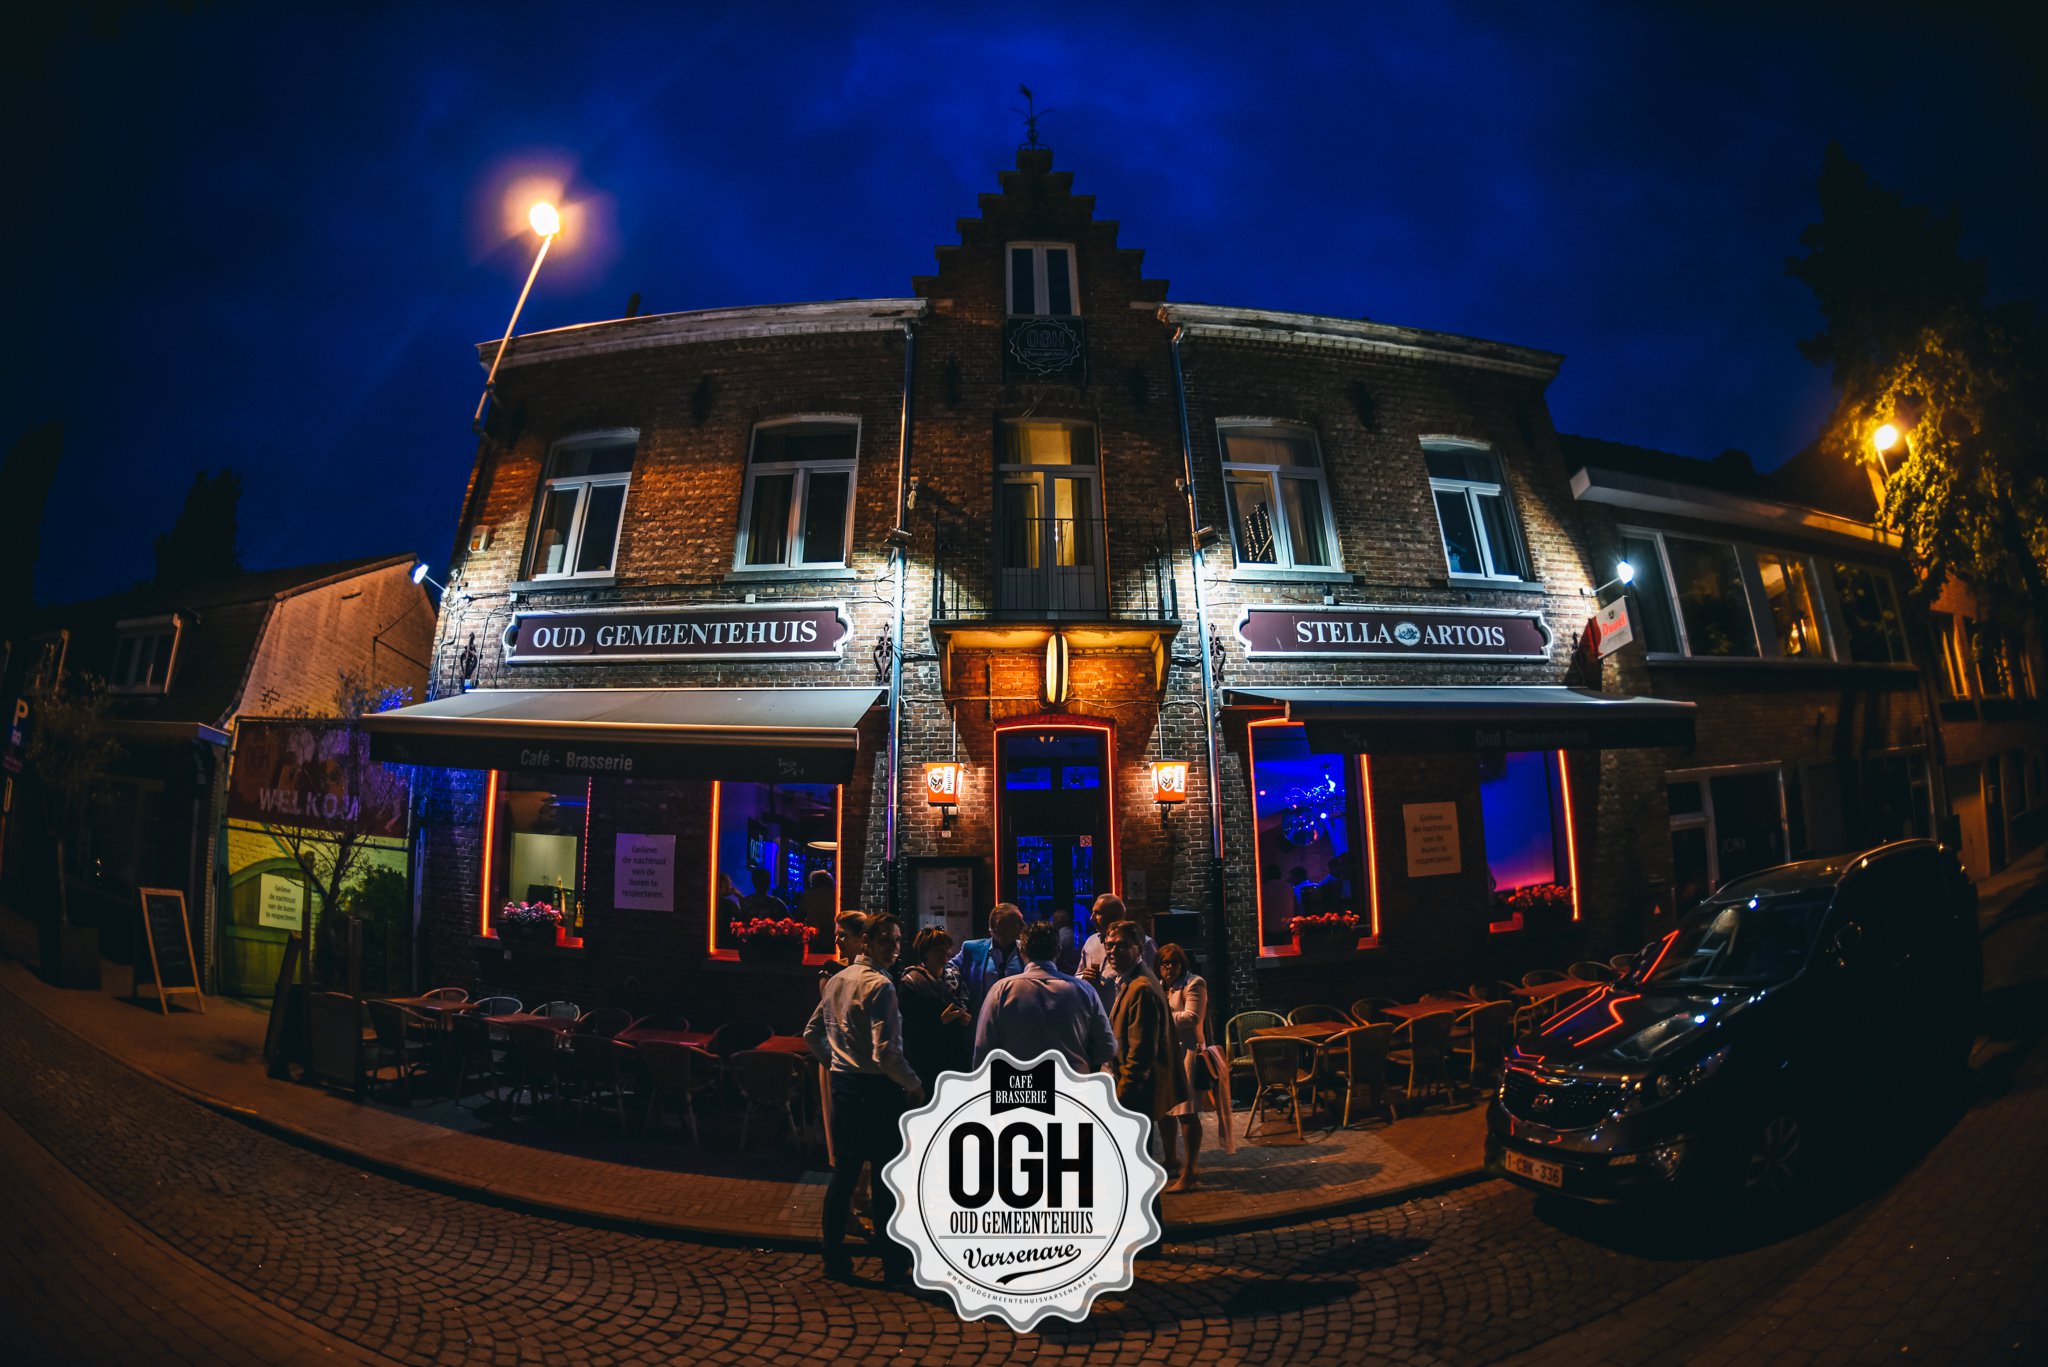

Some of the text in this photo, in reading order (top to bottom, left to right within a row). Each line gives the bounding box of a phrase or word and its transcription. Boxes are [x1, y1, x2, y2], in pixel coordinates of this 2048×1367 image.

[1026, 329, 1065, 348] OGH
[533, 620, 817, 648] OUD GEMEENTEHUIS
[1297, 621, 1505, 647] STELLA ARTOIS
[1602, 611, 1627, 637] Duvel
[13, 698, 29, 727] P
[520, 748, 550, 766] Café
[566, 751, 633, 771] Brasserie
[631, 845, 658, 854] Gelieve
[622, 856, 666, 866] de nachtrust
[646, 868, 656, 876] de
[629, 879, 658, 887] buren te
